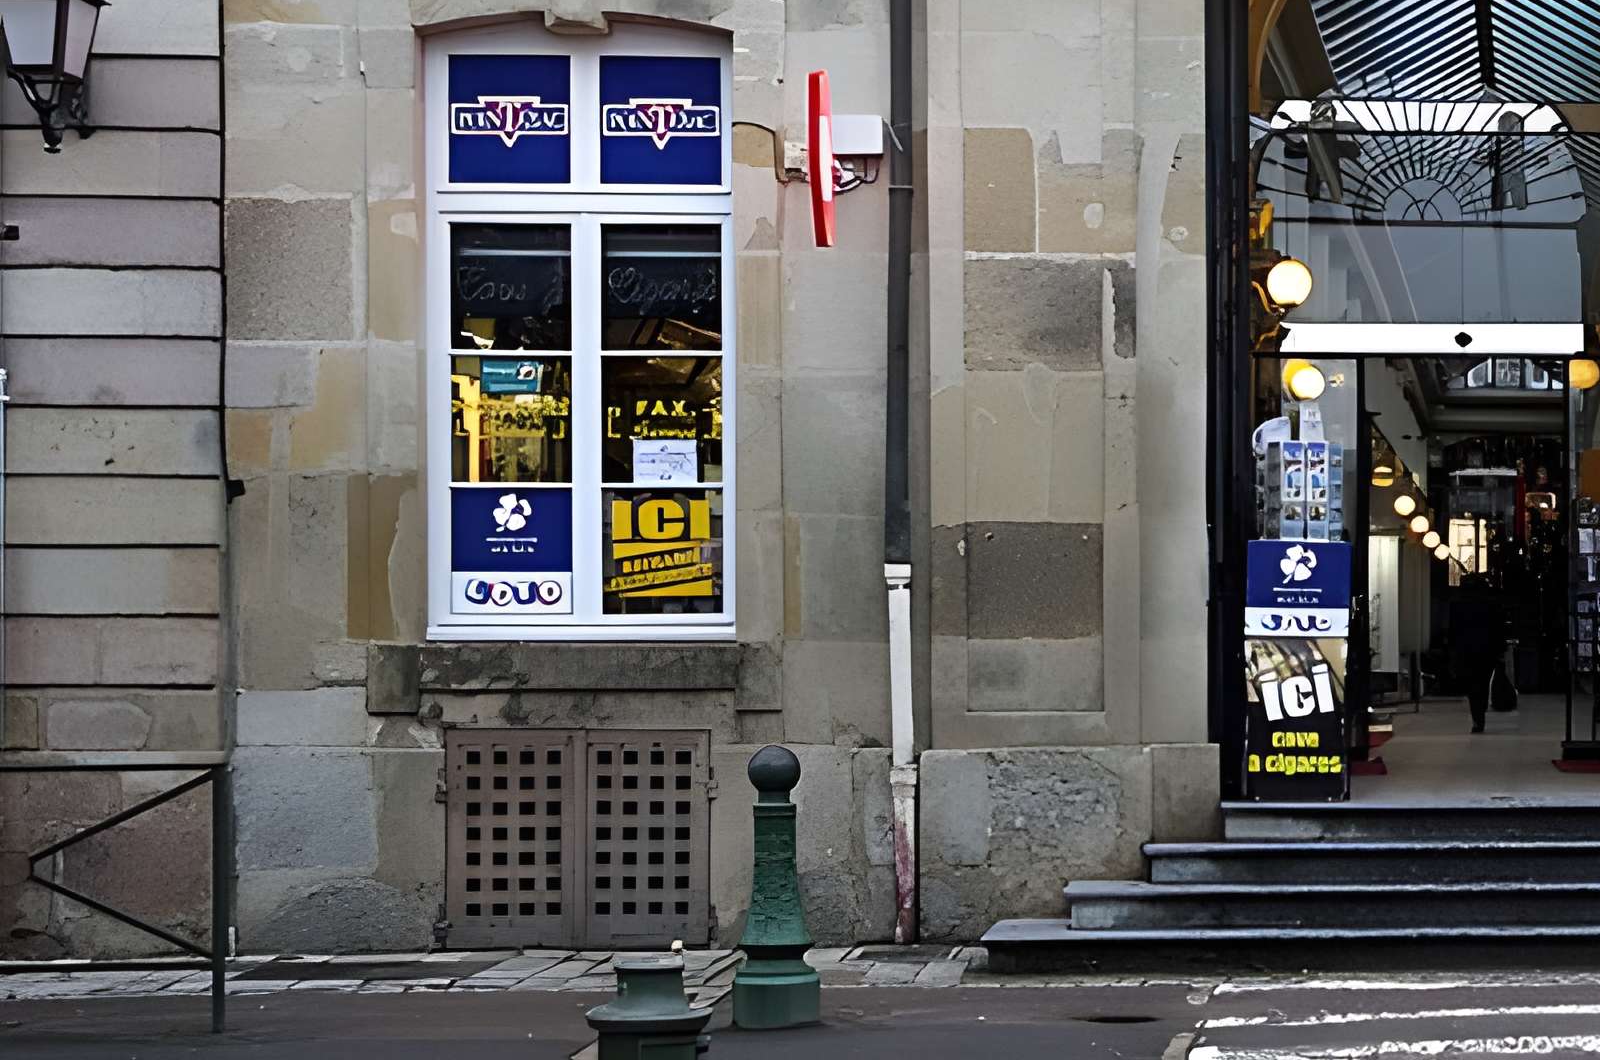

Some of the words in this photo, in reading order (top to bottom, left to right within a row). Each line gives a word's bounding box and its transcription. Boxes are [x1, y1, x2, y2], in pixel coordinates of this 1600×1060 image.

[611, 498, 711, 541] ICI
[464, 578, 563, 607] LOTO
[1257, 663, 1336, 722] ici
